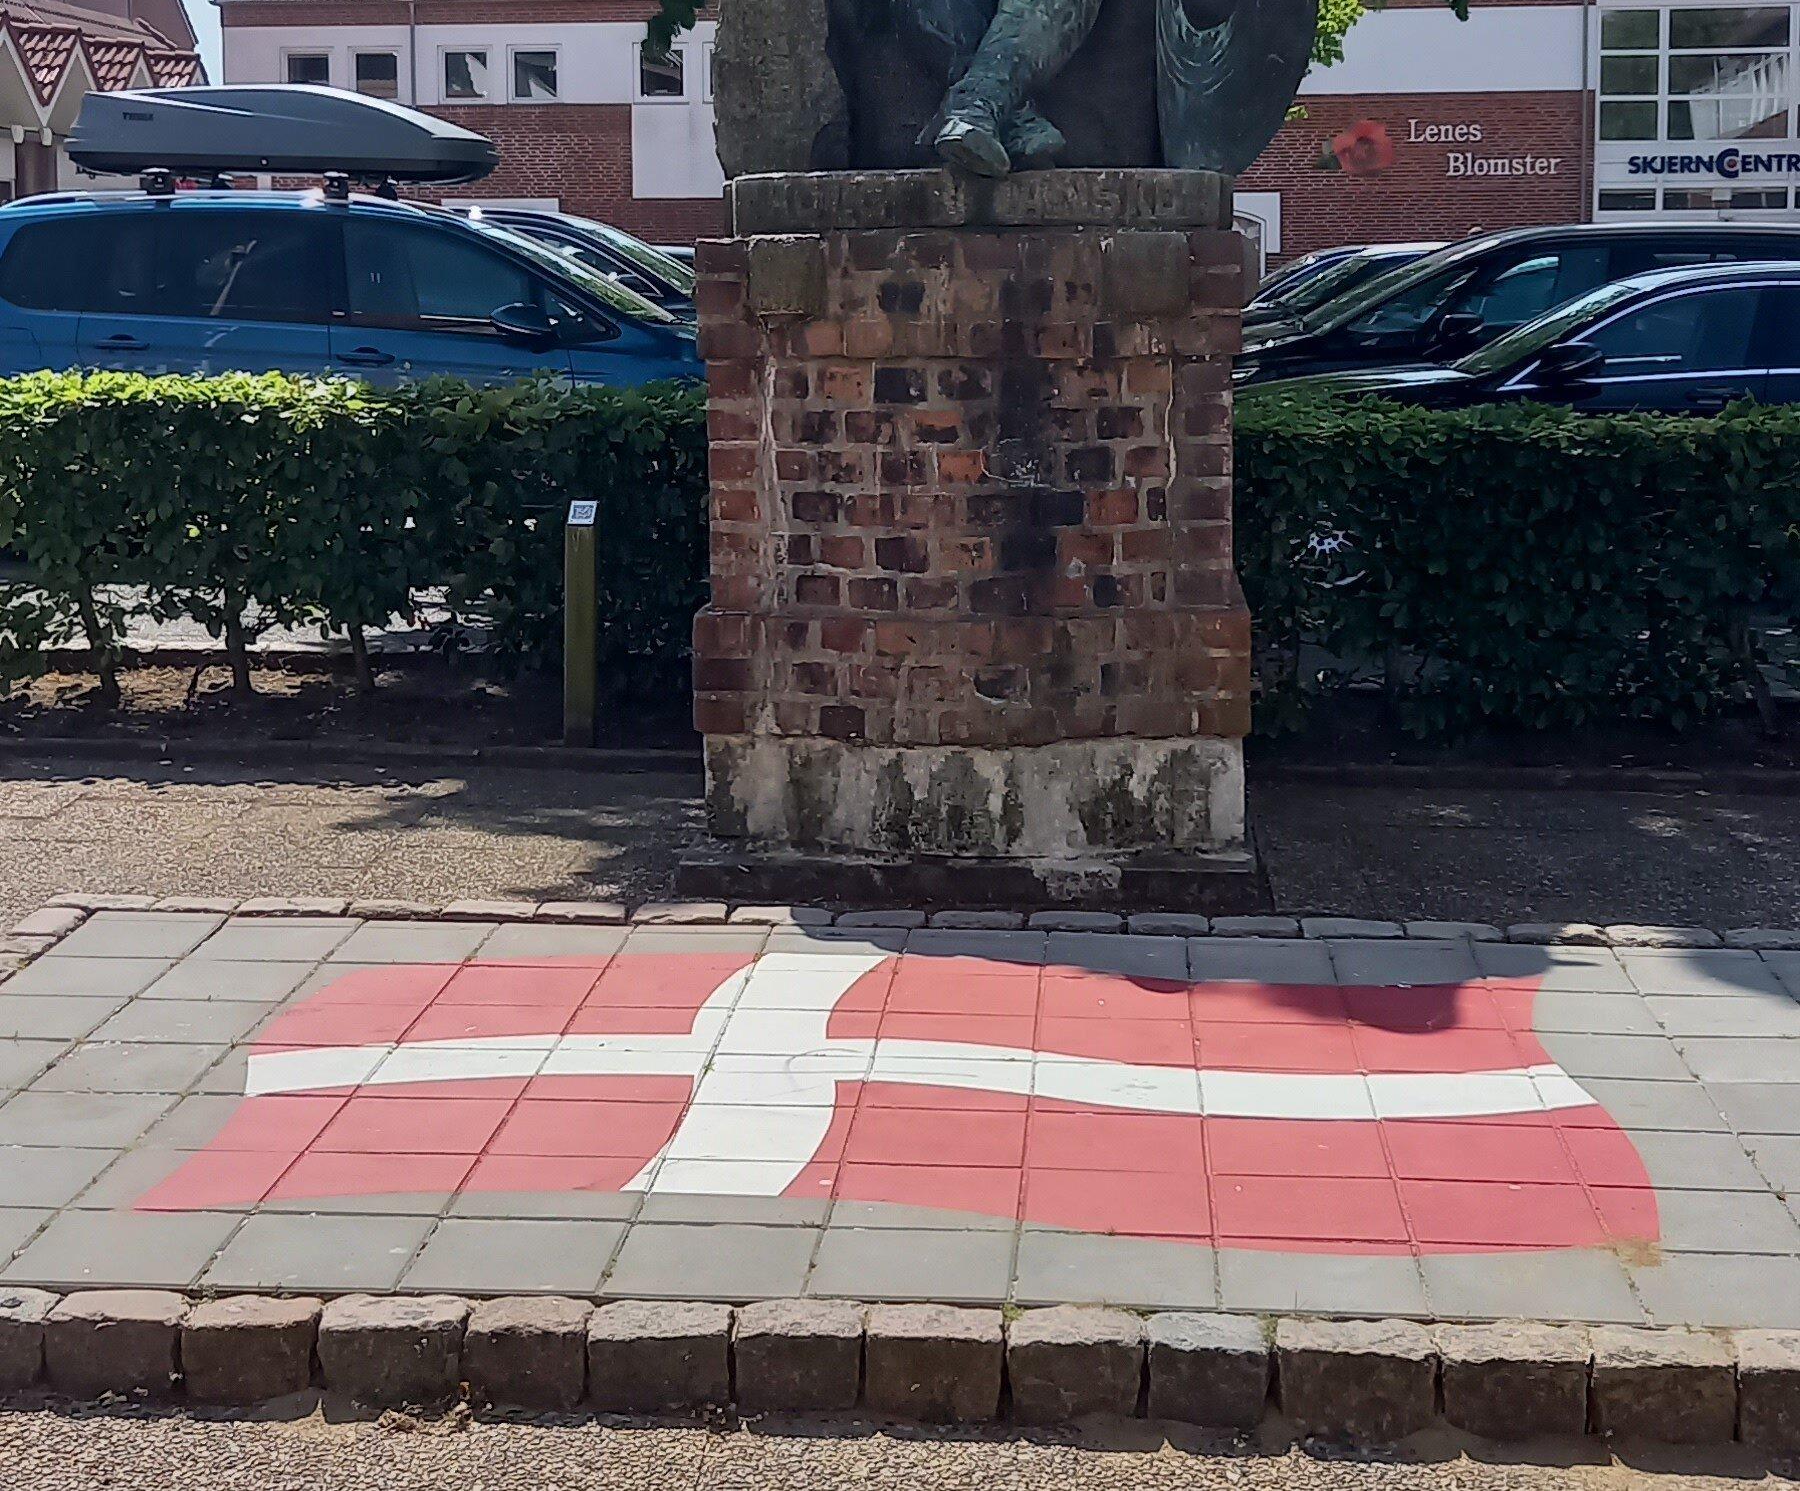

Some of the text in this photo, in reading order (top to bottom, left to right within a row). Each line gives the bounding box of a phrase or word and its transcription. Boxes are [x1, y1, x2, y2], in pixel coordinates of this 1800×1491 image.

[1406, 119, 1482, 142] Lenes
[1446, 152, 1562, 176] Blomster
[1627, 147, 1800, 179] SKJERNCENTR
